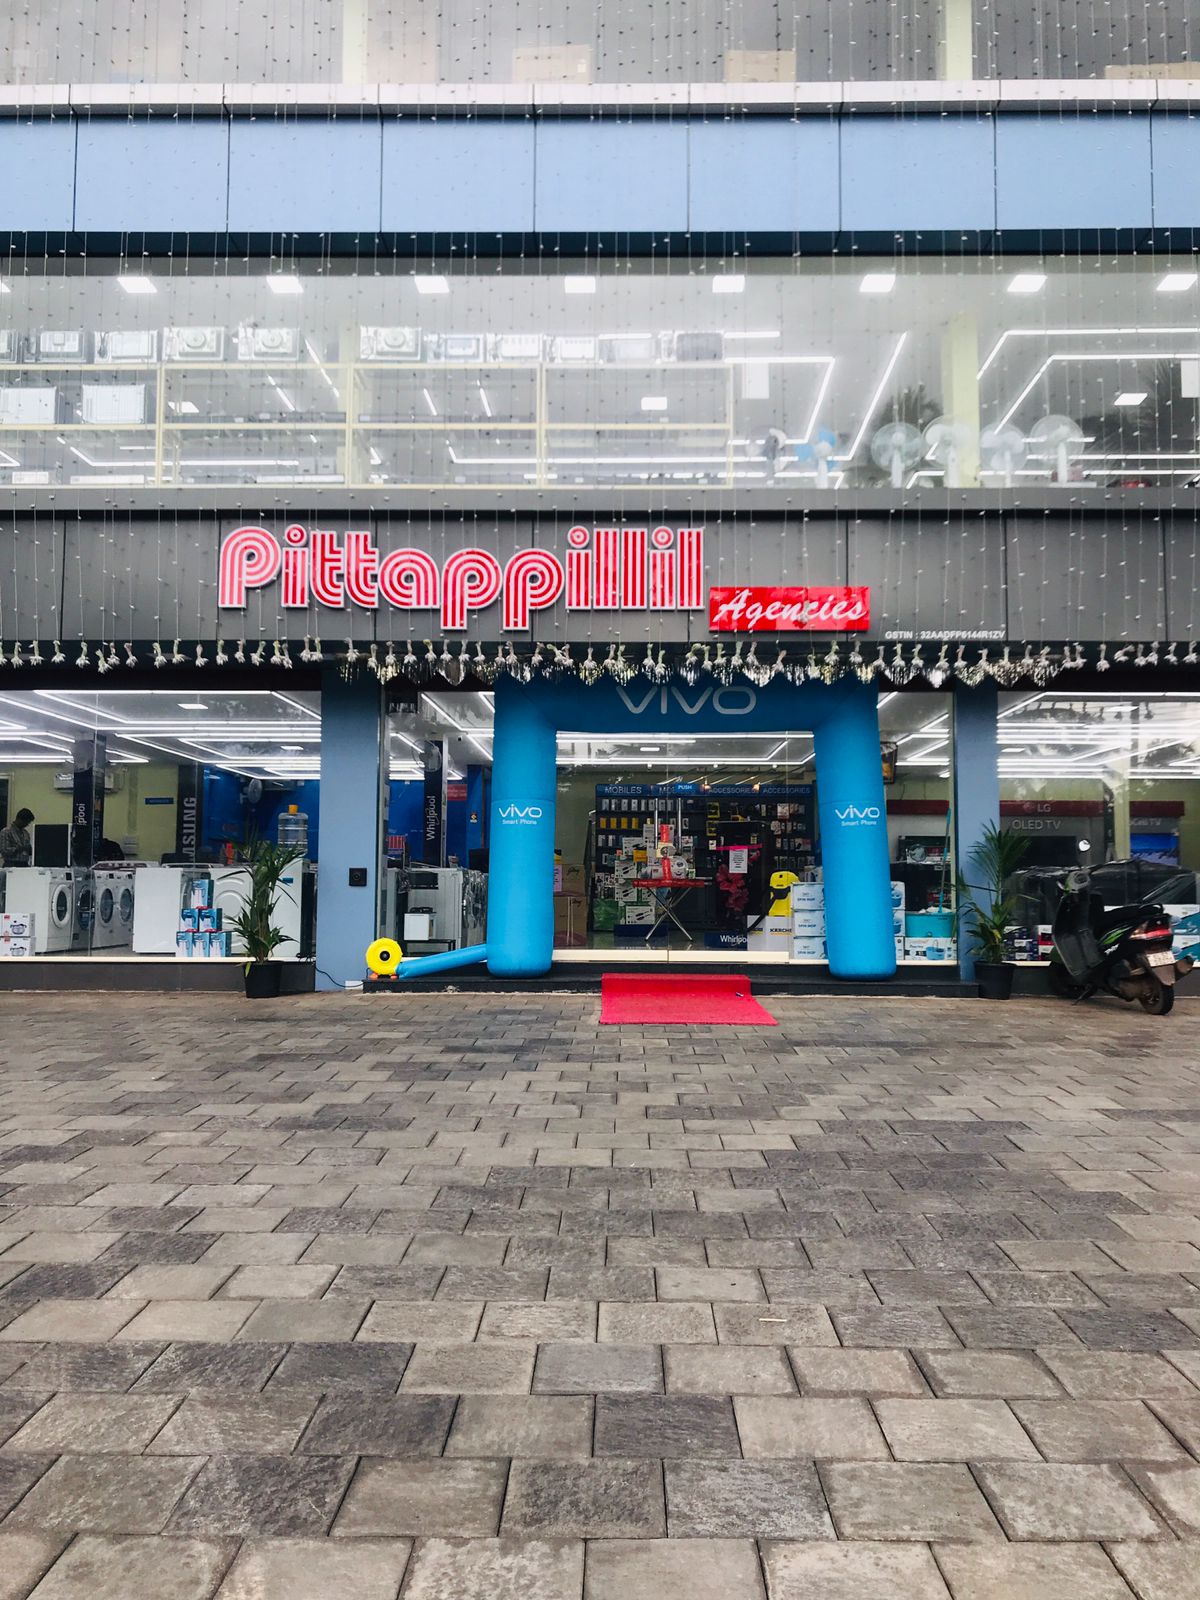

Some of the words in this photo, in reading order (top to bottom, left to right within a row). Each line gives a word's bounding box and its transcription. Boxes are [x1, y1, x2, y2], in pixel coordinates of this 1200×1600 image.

[218, 523, 704, 631] Pittappillil
[712, 588, 867, 624] Agencies
[885, 630, 913, 639] GSTIN
[605, 786, 642, 794] MOBILES
[499, 804, 543, 818] vivo
[835, 804, 880, 819] vivo
[1037, 804, 1051, 813] LG
[425, 795, 438, 841] Whirlpool
[1012, 819, 1043, 830] OLED
[1046, 819, 1061, 830] TV
[720, 934, 747, 946] Whirlpo
